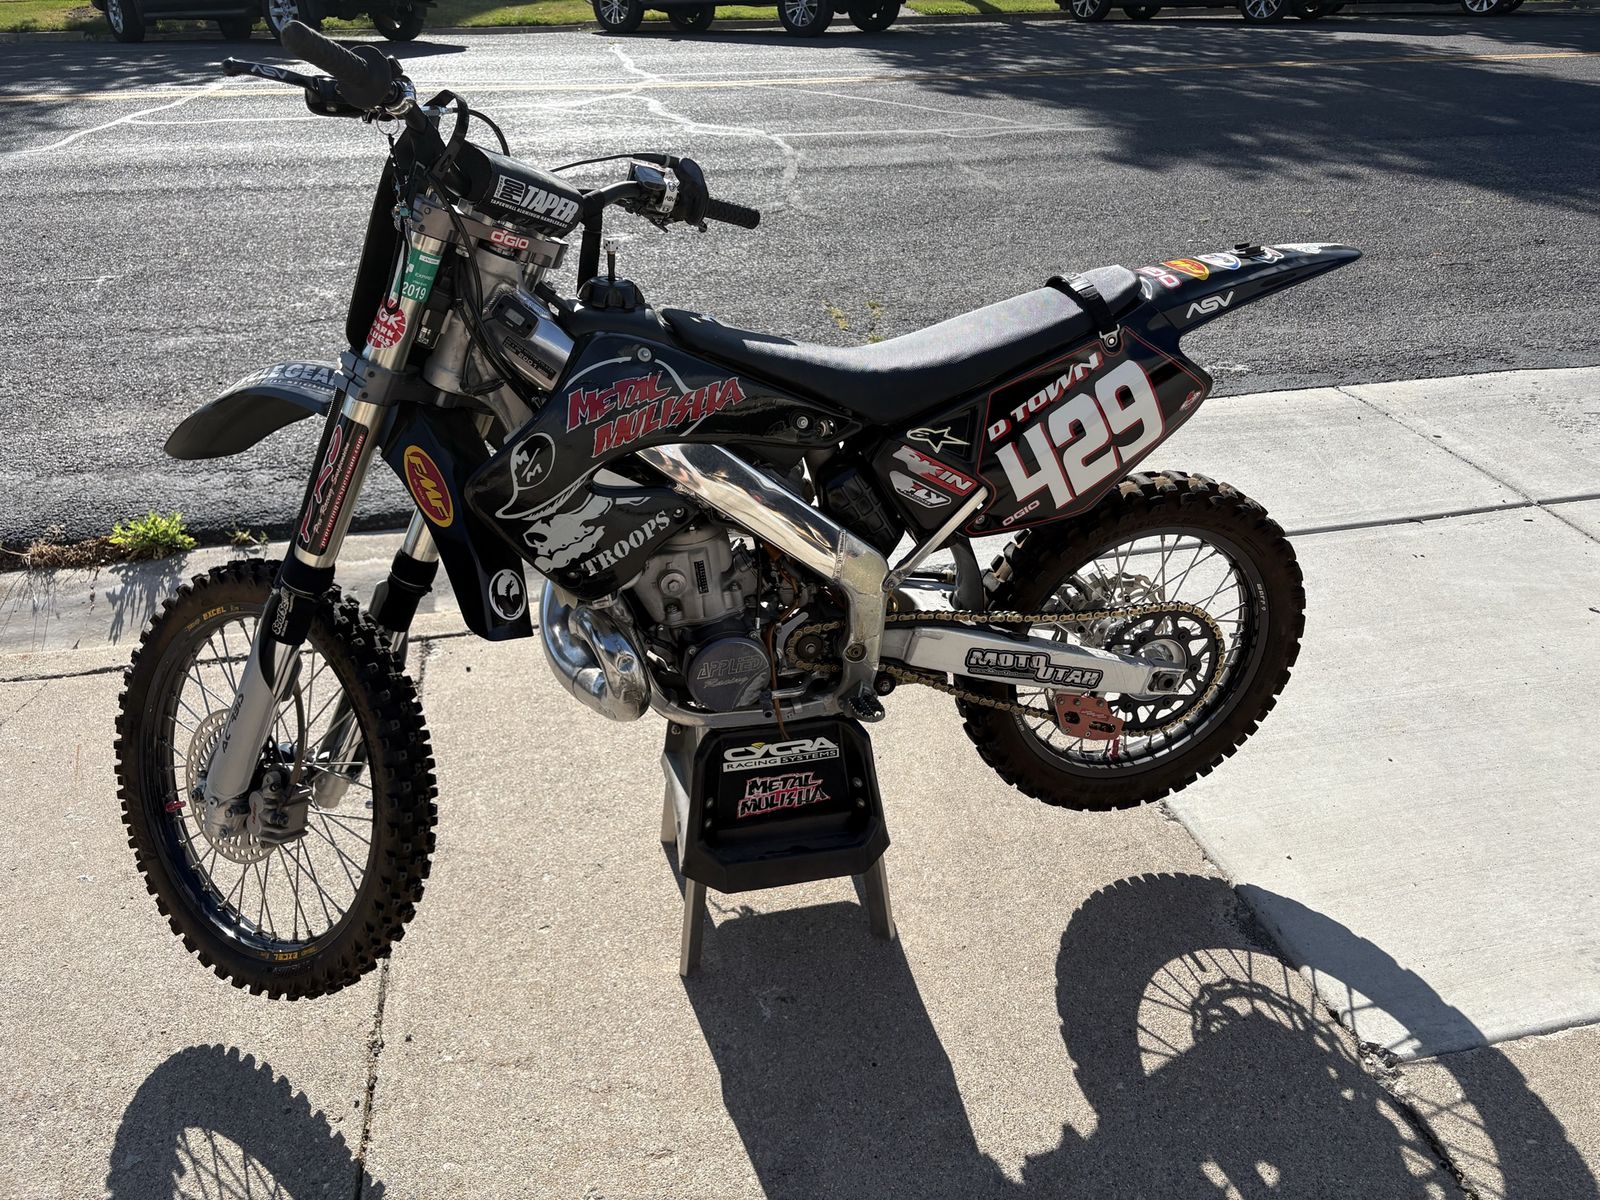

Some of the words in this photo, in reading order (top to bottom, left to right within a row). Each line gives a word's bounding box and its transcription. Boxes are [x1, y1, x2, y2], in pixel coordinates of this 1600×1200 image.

[520, 185, 580, 223] TAPER
[402, 281, 427, 301] 2019
[378, 305, 402, 330] GK
[1186, 291, 1234, 319] ASV
[566, 370, 672, 433] METAL
[987, 419, 1011, 442] D
[1010, 352, 1104, 423] TOWN
[591, 376, 746, 459] MULISHA
[995, 359, 1165, 510] 429
[407, 455, 450, 518] FMF
[1002, 500, 1040, 527] OGIO
[580, 510, 670, 577] TROOPS
[202, 606, 227, 621] EXCEL
[697, 655, 762, 680] APPLIED
[969, 651, 1046, 668] MOTO
[1036, 662, 1100, 686] UTAH
[724, 737, 838, 761] CYCRA
[726, 757, 778, 770] RACING
[780, 750, 836, 764] SYSTEMS
[744, 772, 823, 799] METAL
[737, 784, 831, 818] MULISHA
